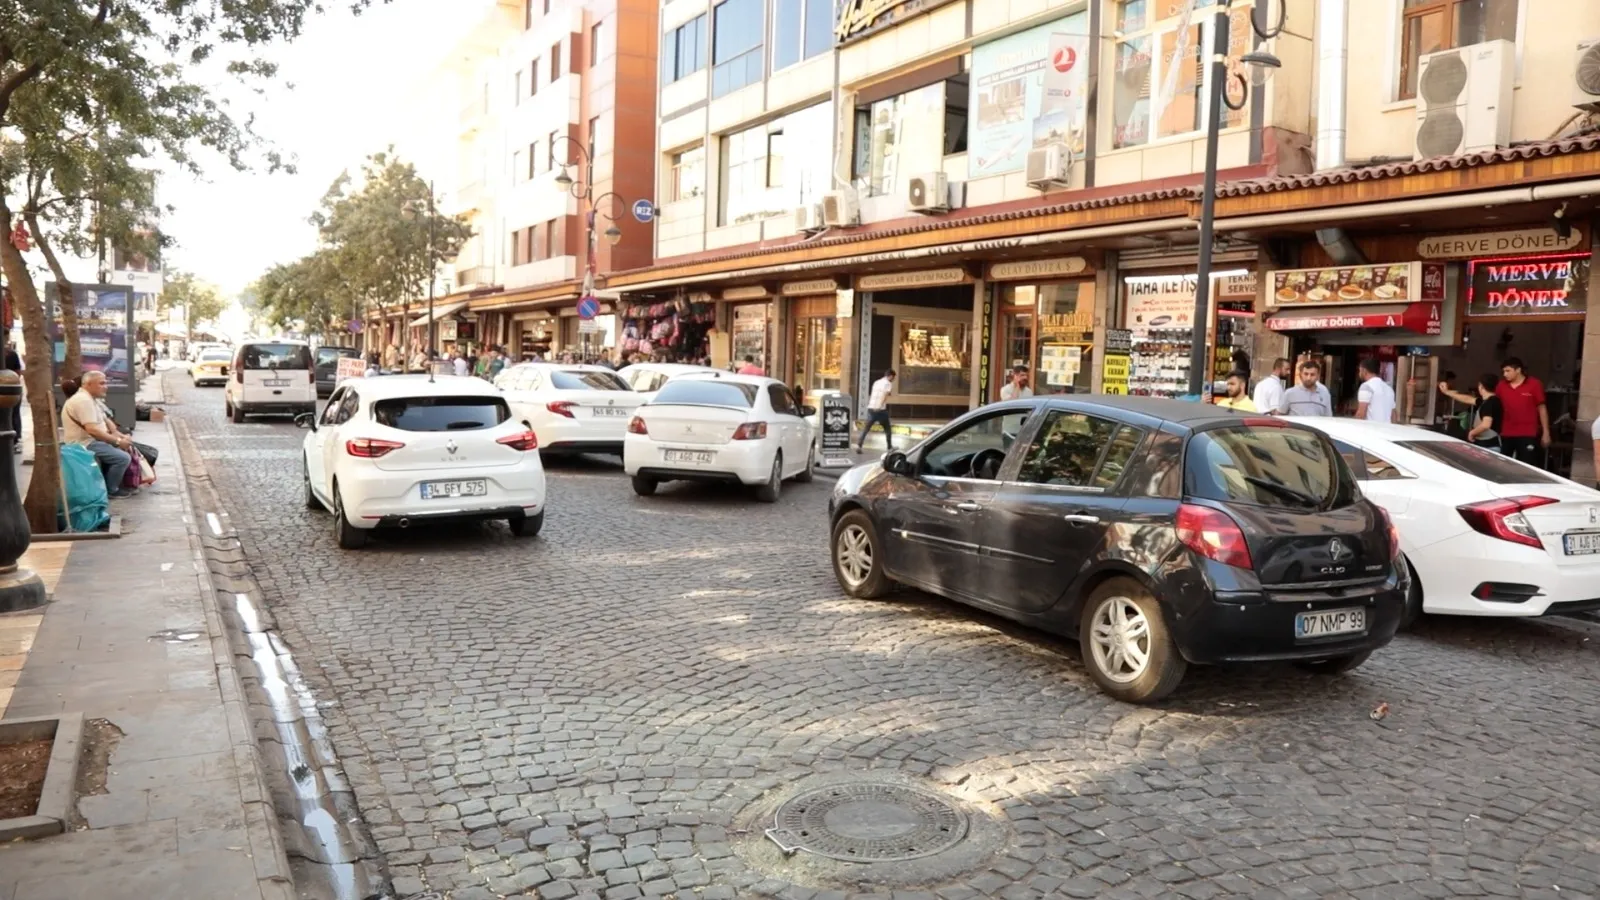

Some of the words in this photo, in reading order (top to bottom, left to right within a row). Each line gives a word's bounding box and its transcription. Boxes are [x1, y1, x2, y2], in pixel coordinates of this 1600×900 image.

[1426, 239, 1489, 255] MERVE
[1497, 234, 1569, 250] DÖNER
[1001, 267, 1023, 276] OLAY
[1488, 261, 1571, 283] MERVE
[1131, 281, 1158, 296] TAHA
[1488, 288, 1568, 308] DÖNER
[982, 303, 991, 349] OLAY
[1295, 317, 1328, 328] MERVE
[1330, 316, 1364, 327] DÖNER
[980, 355, 988, 407] DÖVİ
[428, 483, 440, 495] 34
[444, 482, 461, 494] GFY
[466, 481, 484, 493] 575
[1321, 566, 1346, 574] CLIO
[1303, 616, 1317, 634] 07
[1320, 613, 1346, 632] NMP
[1349, 611, 1363, 628] 99
